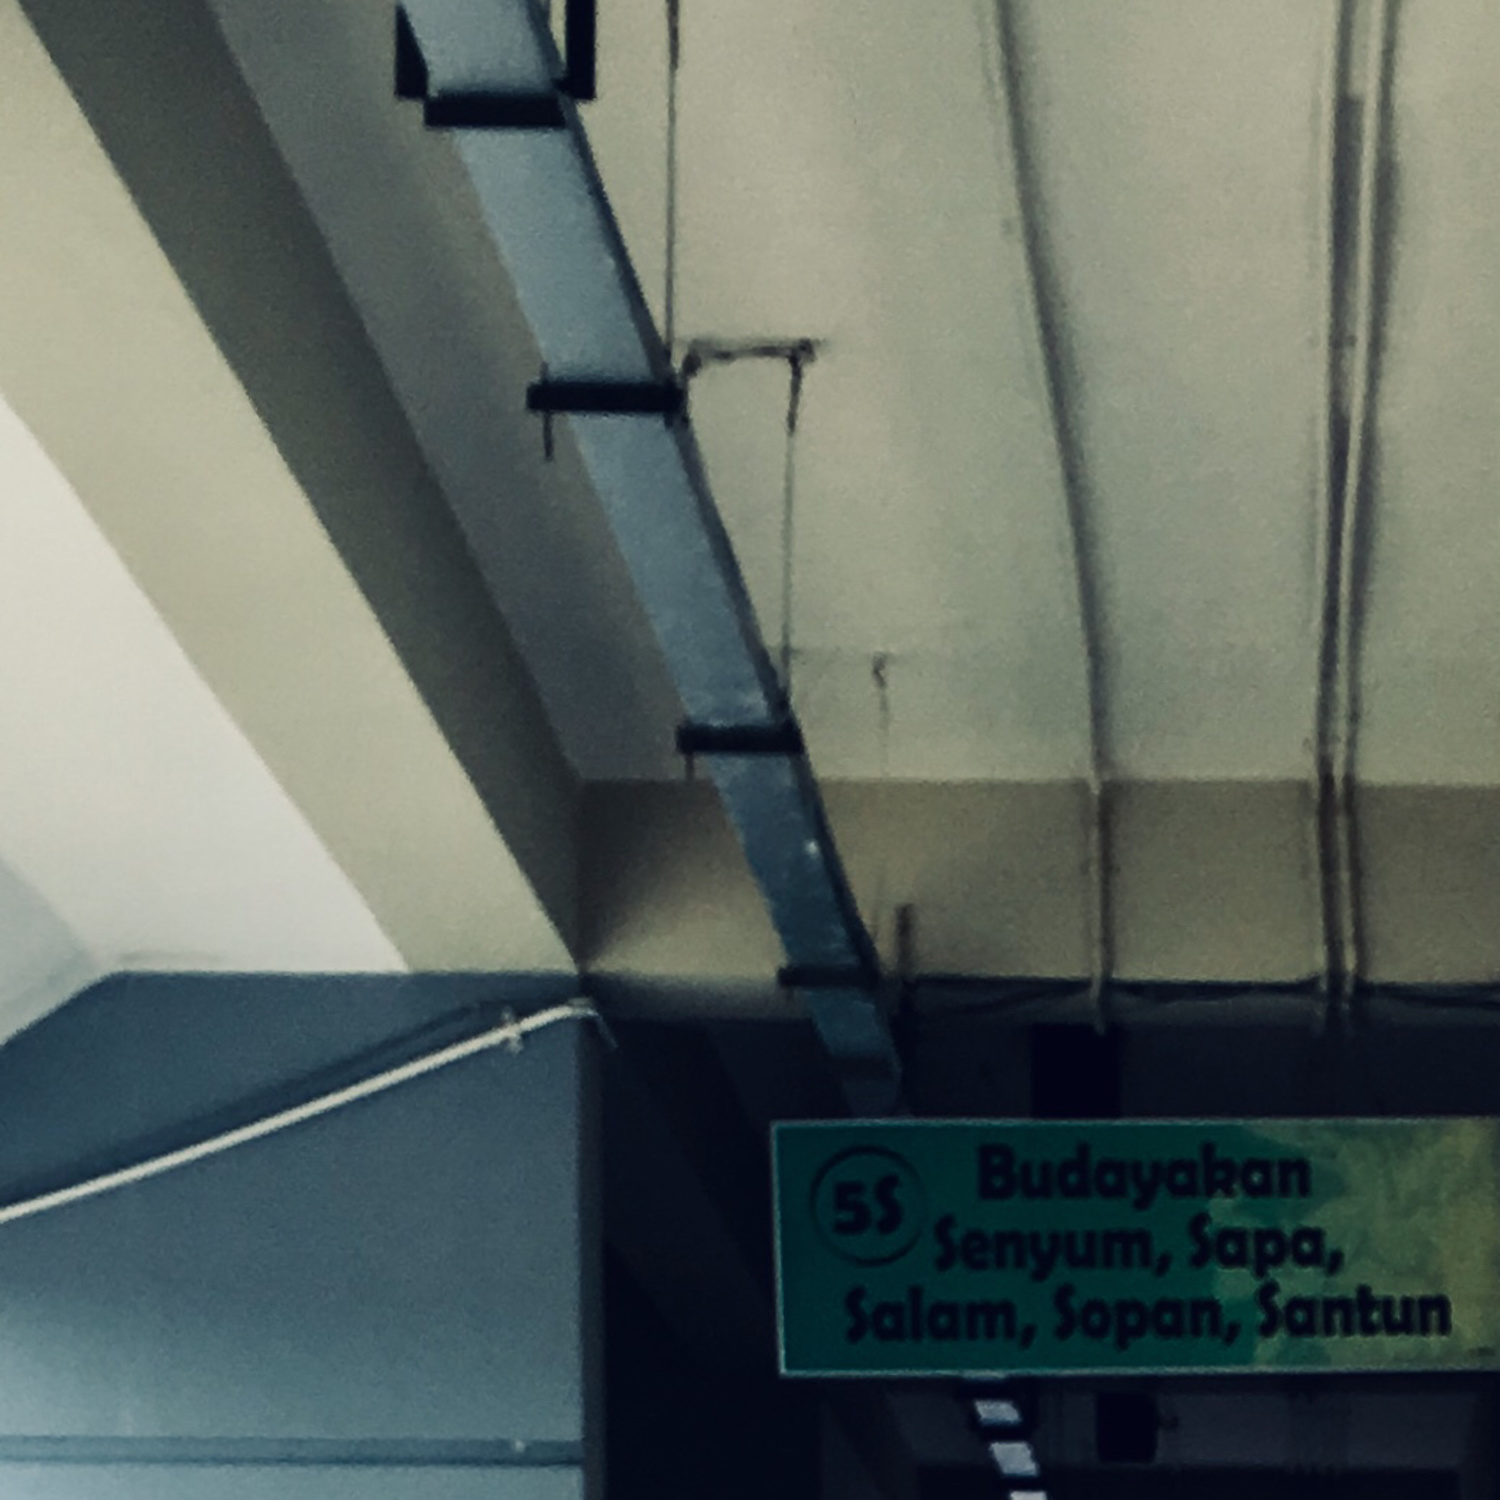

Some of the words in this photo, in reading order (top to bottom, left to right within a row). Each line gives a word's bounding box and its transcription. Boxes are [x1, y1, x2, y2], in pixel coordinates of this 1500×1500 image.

[831, 1176, 903, 1236] 5S
[976, 1142, 1312, 1211] Budayakan
[932, 1214, 1173, 1281] Senyum,
[1188, 1212, 1344, 1277] Sapa,
[845, 1287, 1037, 1349] Salam,
[1053, 1285, 1242, 1350] Sopan,
[1257, 1282, 1452, 1340] Santun
